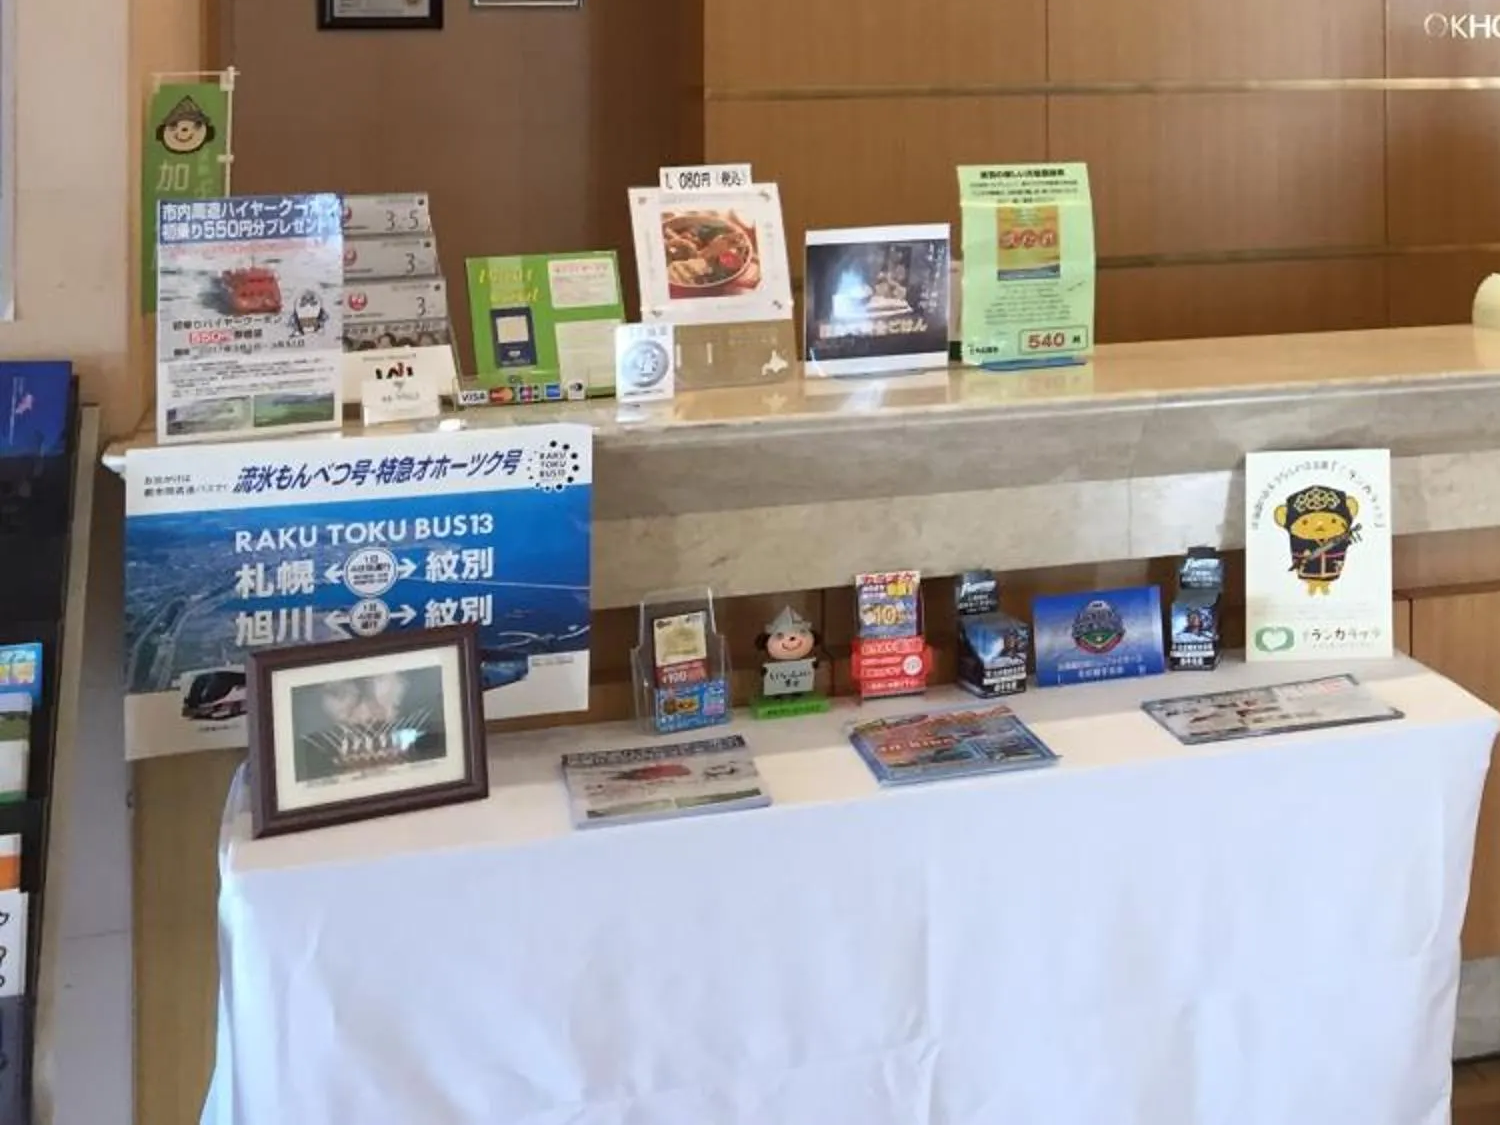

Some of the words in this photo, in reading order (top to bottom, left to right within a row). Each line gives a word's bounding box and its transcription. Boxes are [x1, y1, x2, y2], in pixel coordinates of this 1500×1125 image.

[1028, 332, 1065, 349] 540
[460, 392, 486, 403] VISA
[235, 525, 317, 554] RAKU
[326, 520, 408, 547] TOKU
[414, 512, 495, 541] BUS13
[234, 558, 316, 600] 札幌
[425, 546, 495, 584] 紋別
[234, 605, 314, 648] 旭川
[424, 594, 494, 628] 紋別
